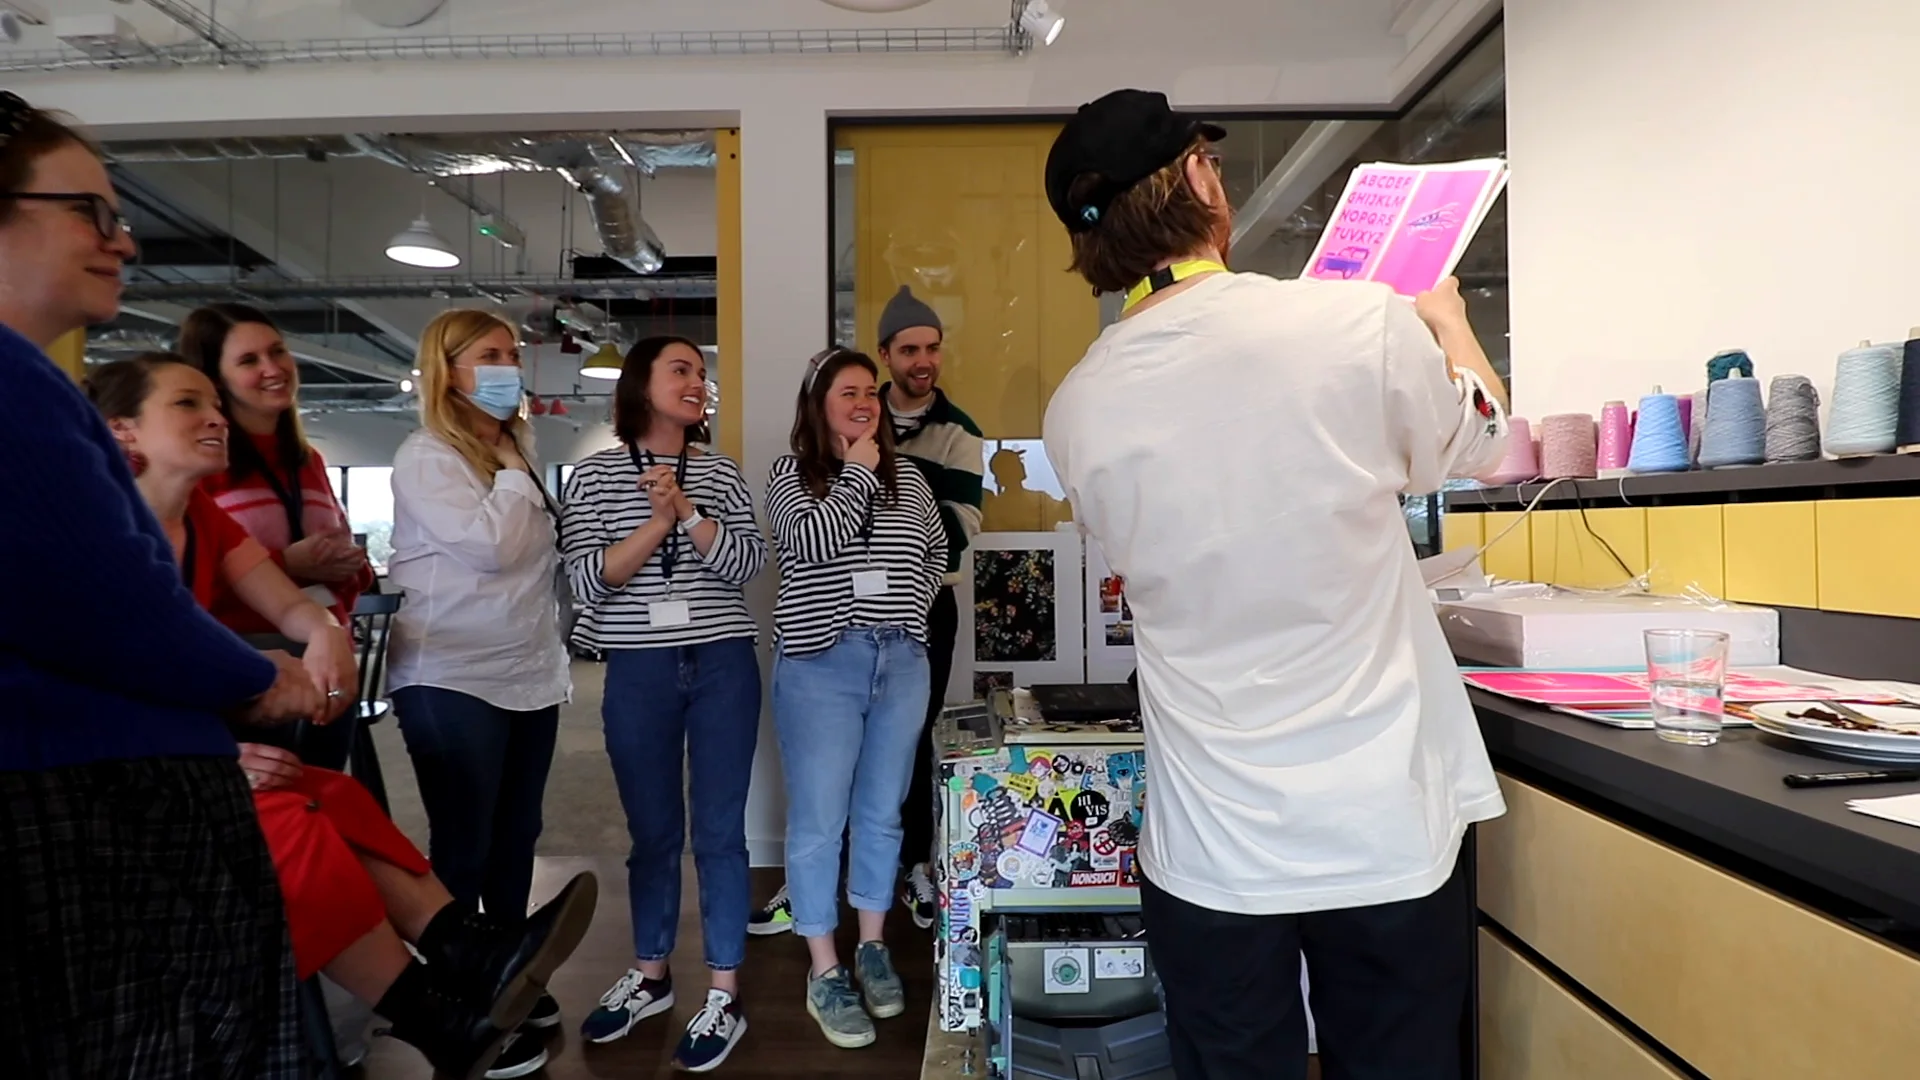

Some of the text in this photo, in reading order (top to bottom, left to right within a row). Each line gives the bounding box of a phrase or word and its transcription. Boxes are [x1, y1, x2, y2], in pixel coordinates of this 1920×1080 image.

[1358, 174, 1412, 189] ABCDEF
[1347, 191, 1407, 208] GHIJKLM
[1338, 209, 1395, 226] NOPQRS
[1333, 226, 1384, 245] TUVXYZ
[1078, 795, 1092, 807] HI
[1085, 804, 1108, 816] VIS
[1071, 872, 1116, 885] NONSUCH
